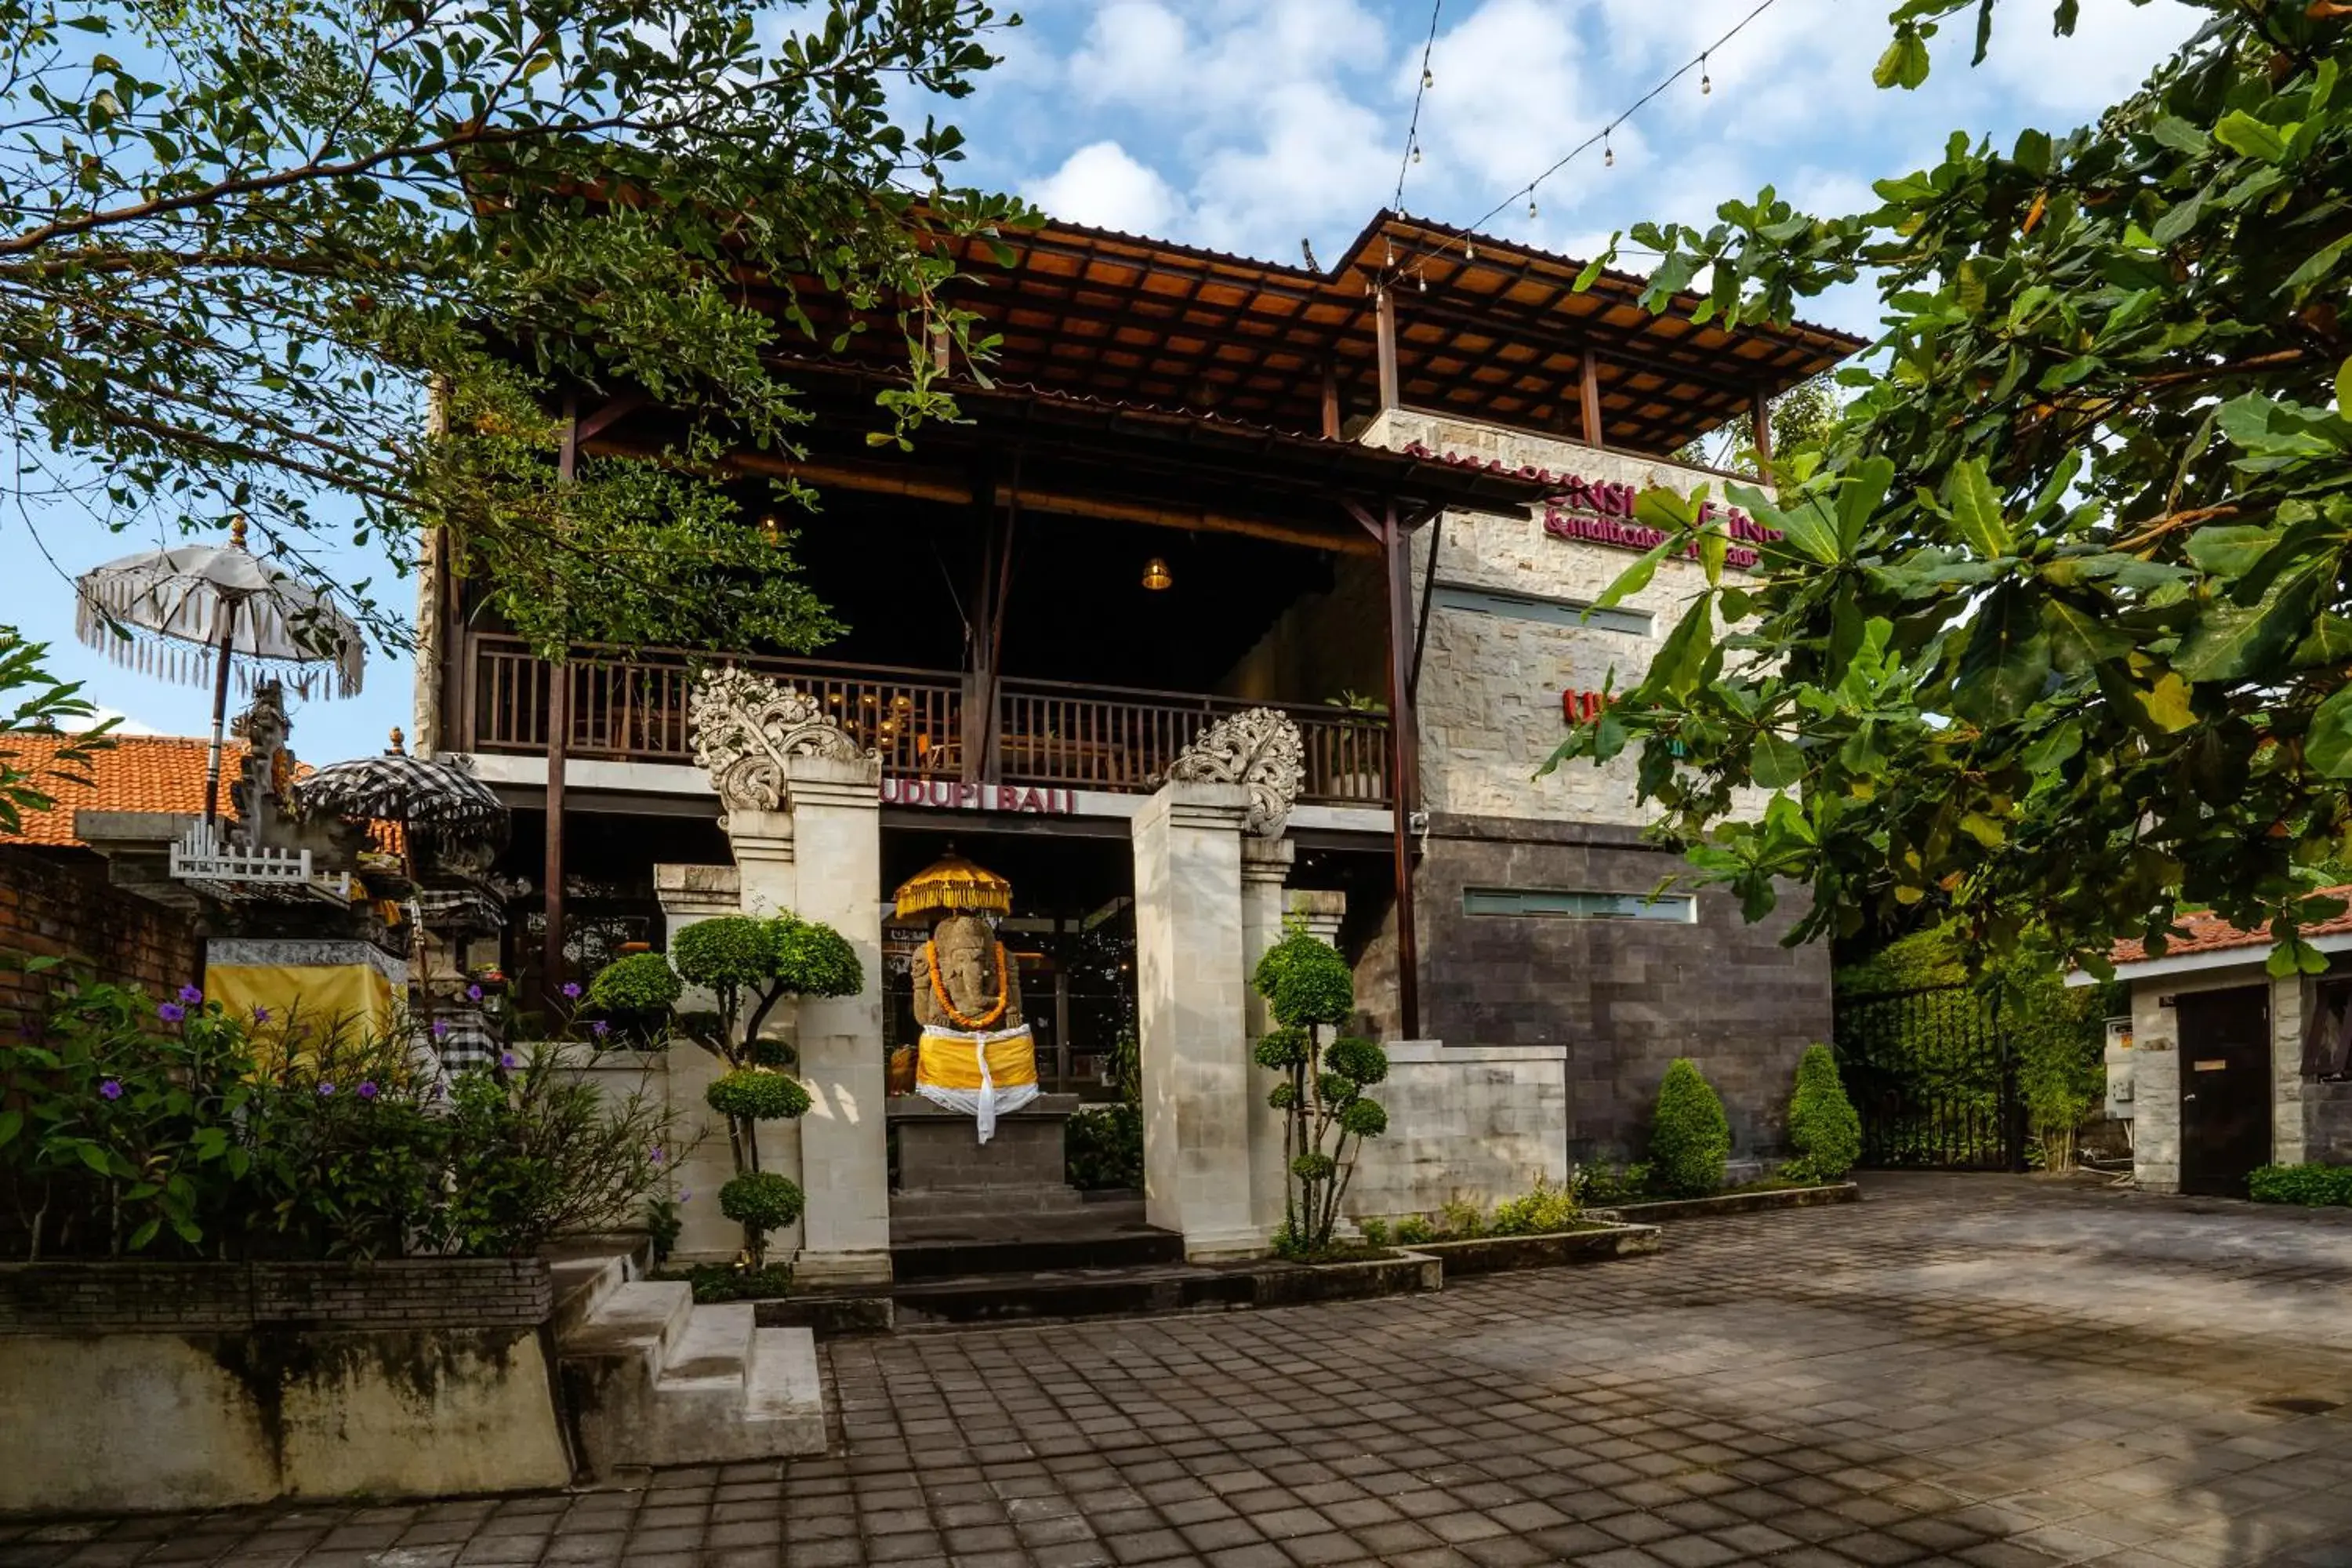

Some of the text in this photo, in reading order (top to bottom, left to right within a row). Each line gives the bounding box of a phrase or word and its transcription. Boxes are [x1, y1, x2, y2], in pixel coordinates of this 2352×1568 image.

[1568, 514, 1664, 548] multicuis
[880, 778, 1076, 815] UDUPI BALI
